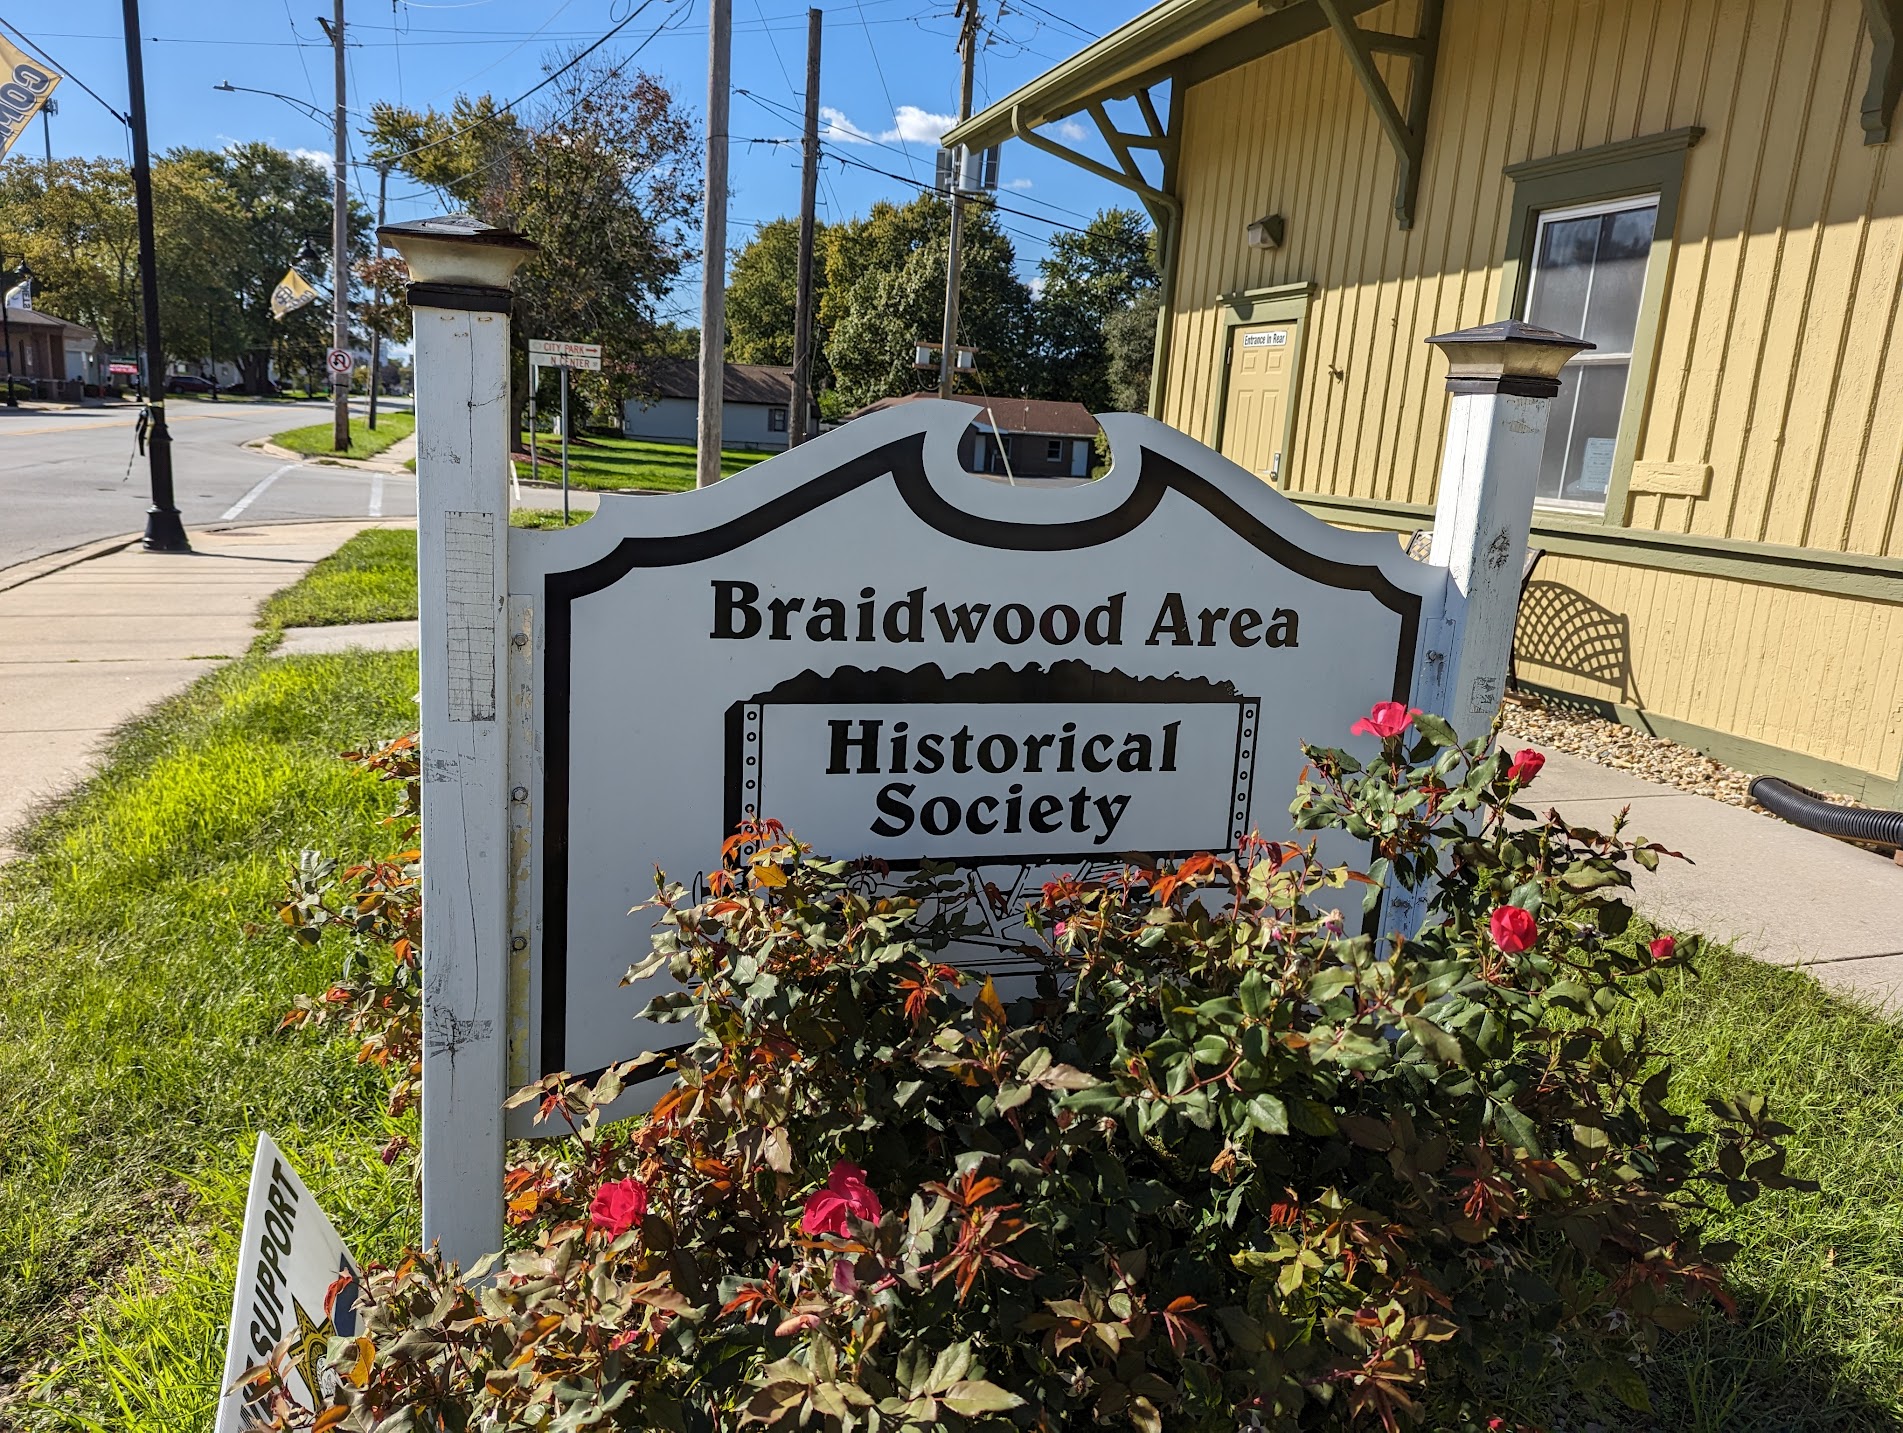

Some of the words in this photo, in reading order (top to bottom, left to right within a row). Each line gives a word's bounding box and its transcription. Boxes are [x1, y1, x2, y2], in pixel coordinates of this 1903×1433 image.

[543, 342, 561, 352] CITY
[564, 344, 585, 355] PARK
[550, 356, 557, 366] N
[560, 356, 590, 368] CENTER
[1244, 335, 1266, 346] Entrance
[1273, 333, 1285, 344] Rear
[709, 579, 1127, 646] Braidwood
[1144, 592, 1299, 649] Area
[825, 719, 1182, 775] Historical
[869, 782, 1132, 846] Society
[249, 1157, 300, 1358] SUPPORT
